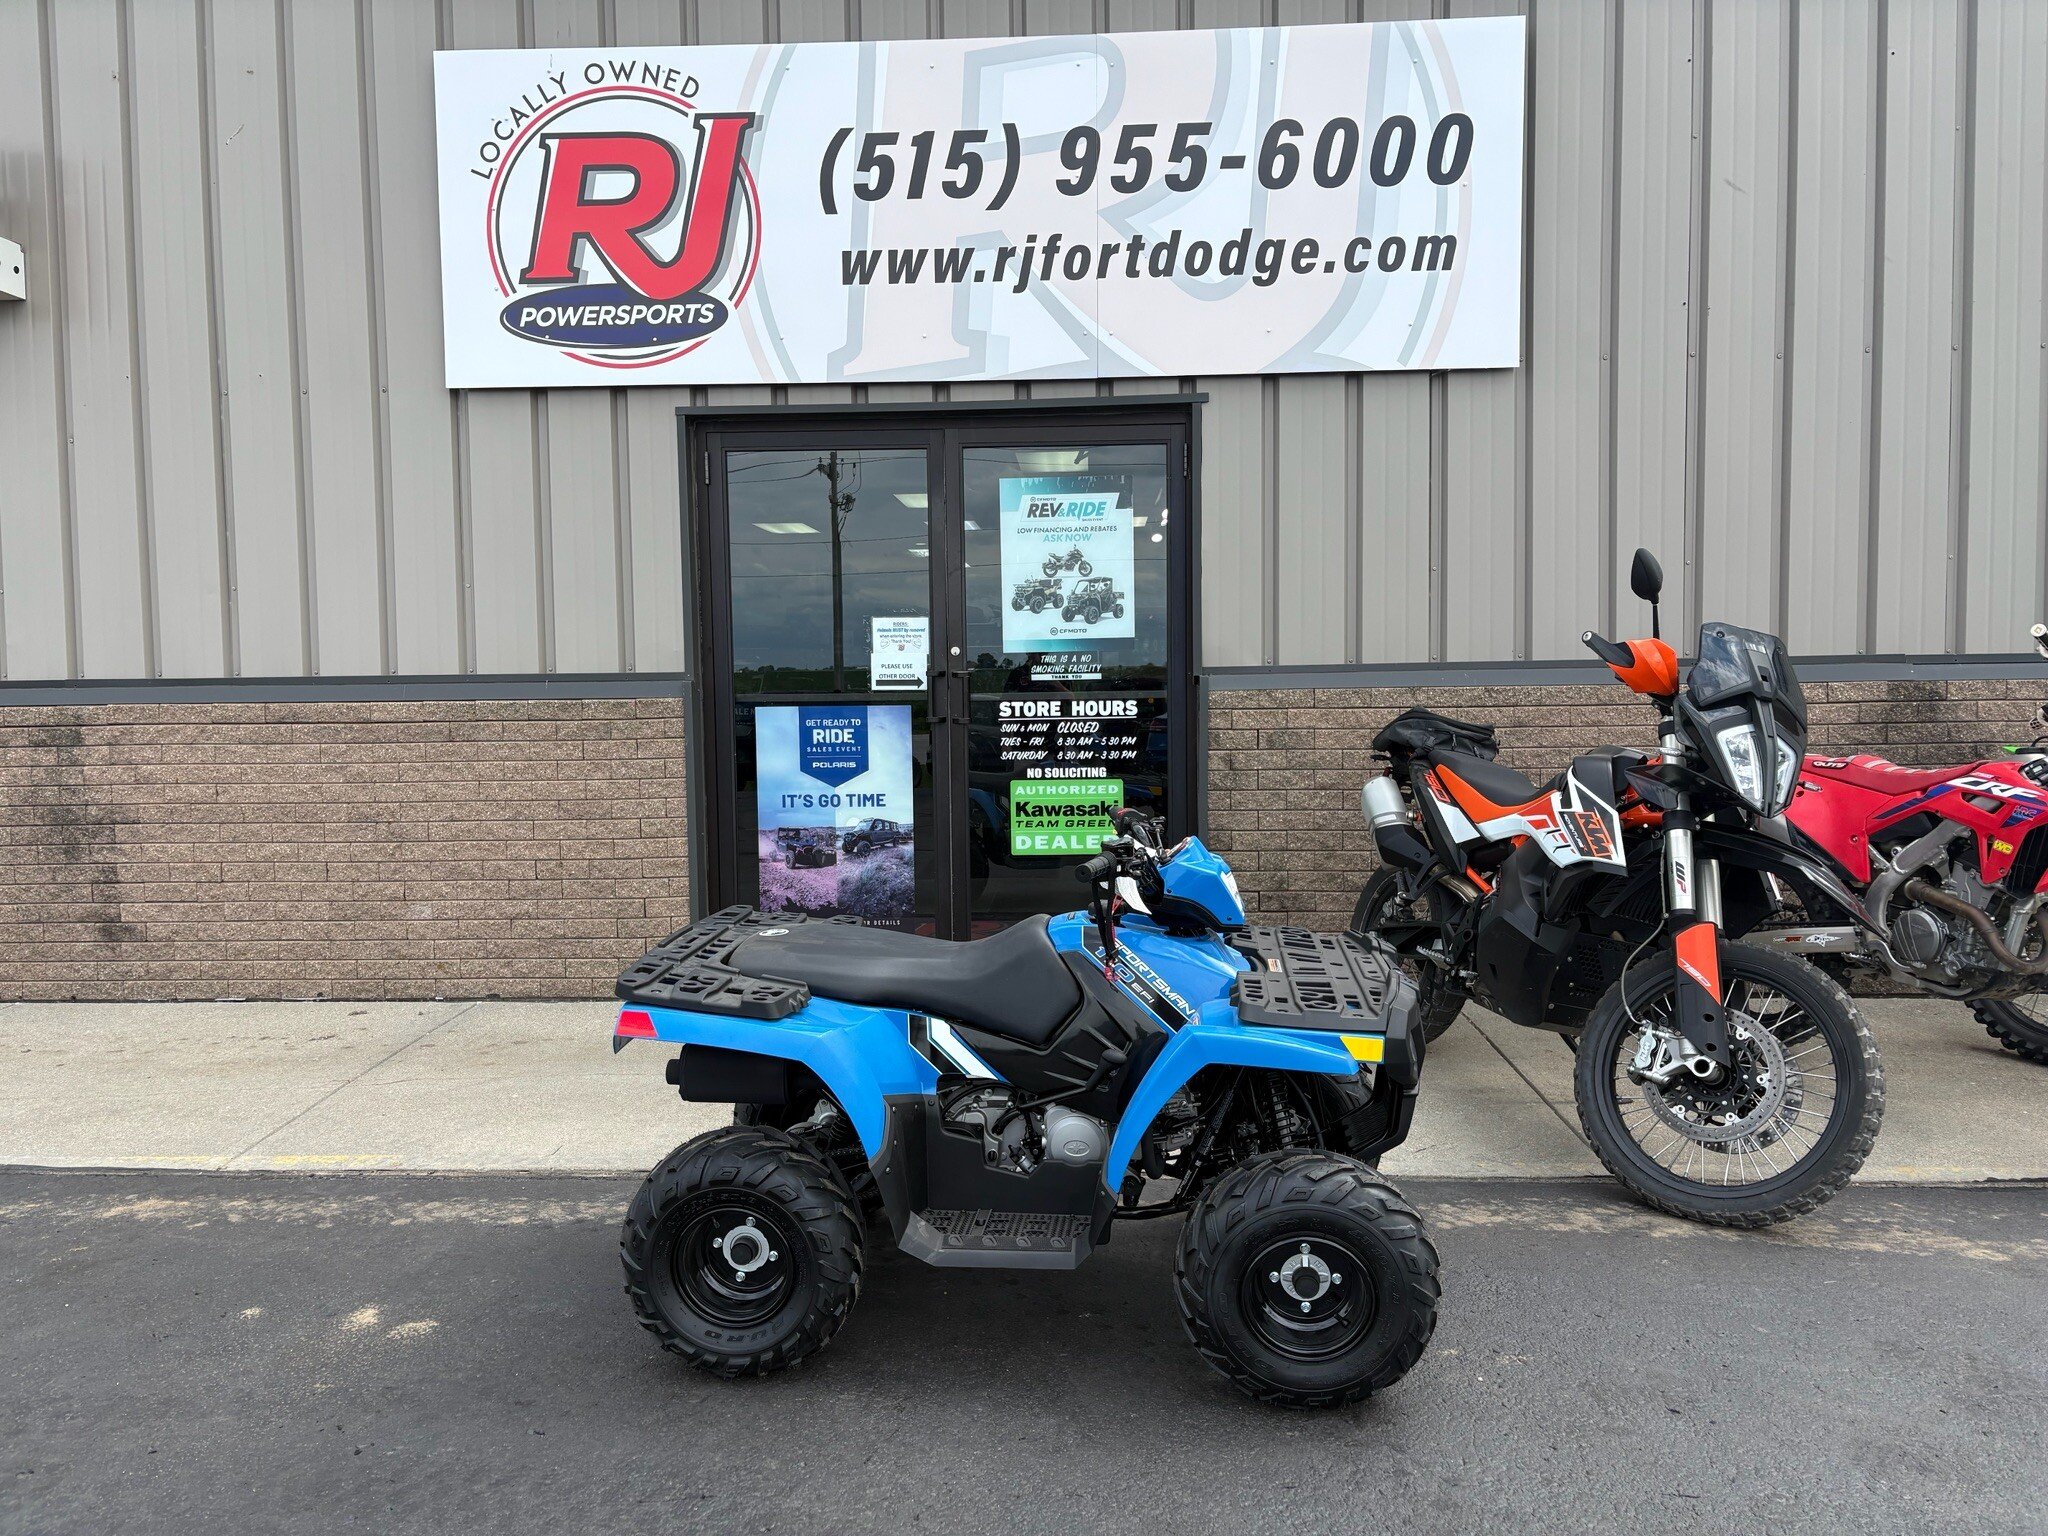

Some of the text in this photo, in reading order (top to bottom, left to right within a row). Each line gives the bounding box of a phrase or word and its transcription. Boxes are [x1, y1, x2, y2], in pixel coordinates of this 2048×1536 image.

[470, 60, 701, 180] LOCALLY OWNED
[819, 112, 1475, 216] (515) 955-6000
[519, 111, 762, 301] RJ
[841, 227, 1458, 295] www.rjfortdodge.com
[519, 303, 715, 328] POWERSPORTS
[1033, 526, 1073, 534] FINANCING
[1090, 525, 1118, 533] REBATES
[1042, 533, 1093, 543] ASK NOW
[1040, 654, 1092, 663] THIS IS A NO
[1030, 663, 1102, 673] SMOKING FACILITY
[999, 700, 1138, 717] STORE HOURS
[822, 718, 849, 726] READY
[850, 718, 861, 726] TO
[1000, 723, 1020, 733] SUN
[1026, 723, 1050, 732] MON
[1057, 721, 1099, 733] CLOSED
[812, 728, 855, 745] RIDE
[1000, 737, 1021, 747] TUES
[1029, 737, 1044, 746] FRI
[1076, 737, 1093, 746] AM
[1121, 736, 1137, 745] PM
[1000, 751, 1048, 760] SATURDAY
[1076, 751, 1093, 760] AM
[1121, 750, 1137, 759] PM
[1027, 767, 1107, 778] NO SOLICITING
[1015, 785, 1119, 795] AUTHORIZED
[1945, 776, 2046, 798] CRF
[781, 793, 887, 809] IT'S GO TIME
[1574, 811, 1613, 857] KTM
[1131, 982, 1155, 1004] EFI
